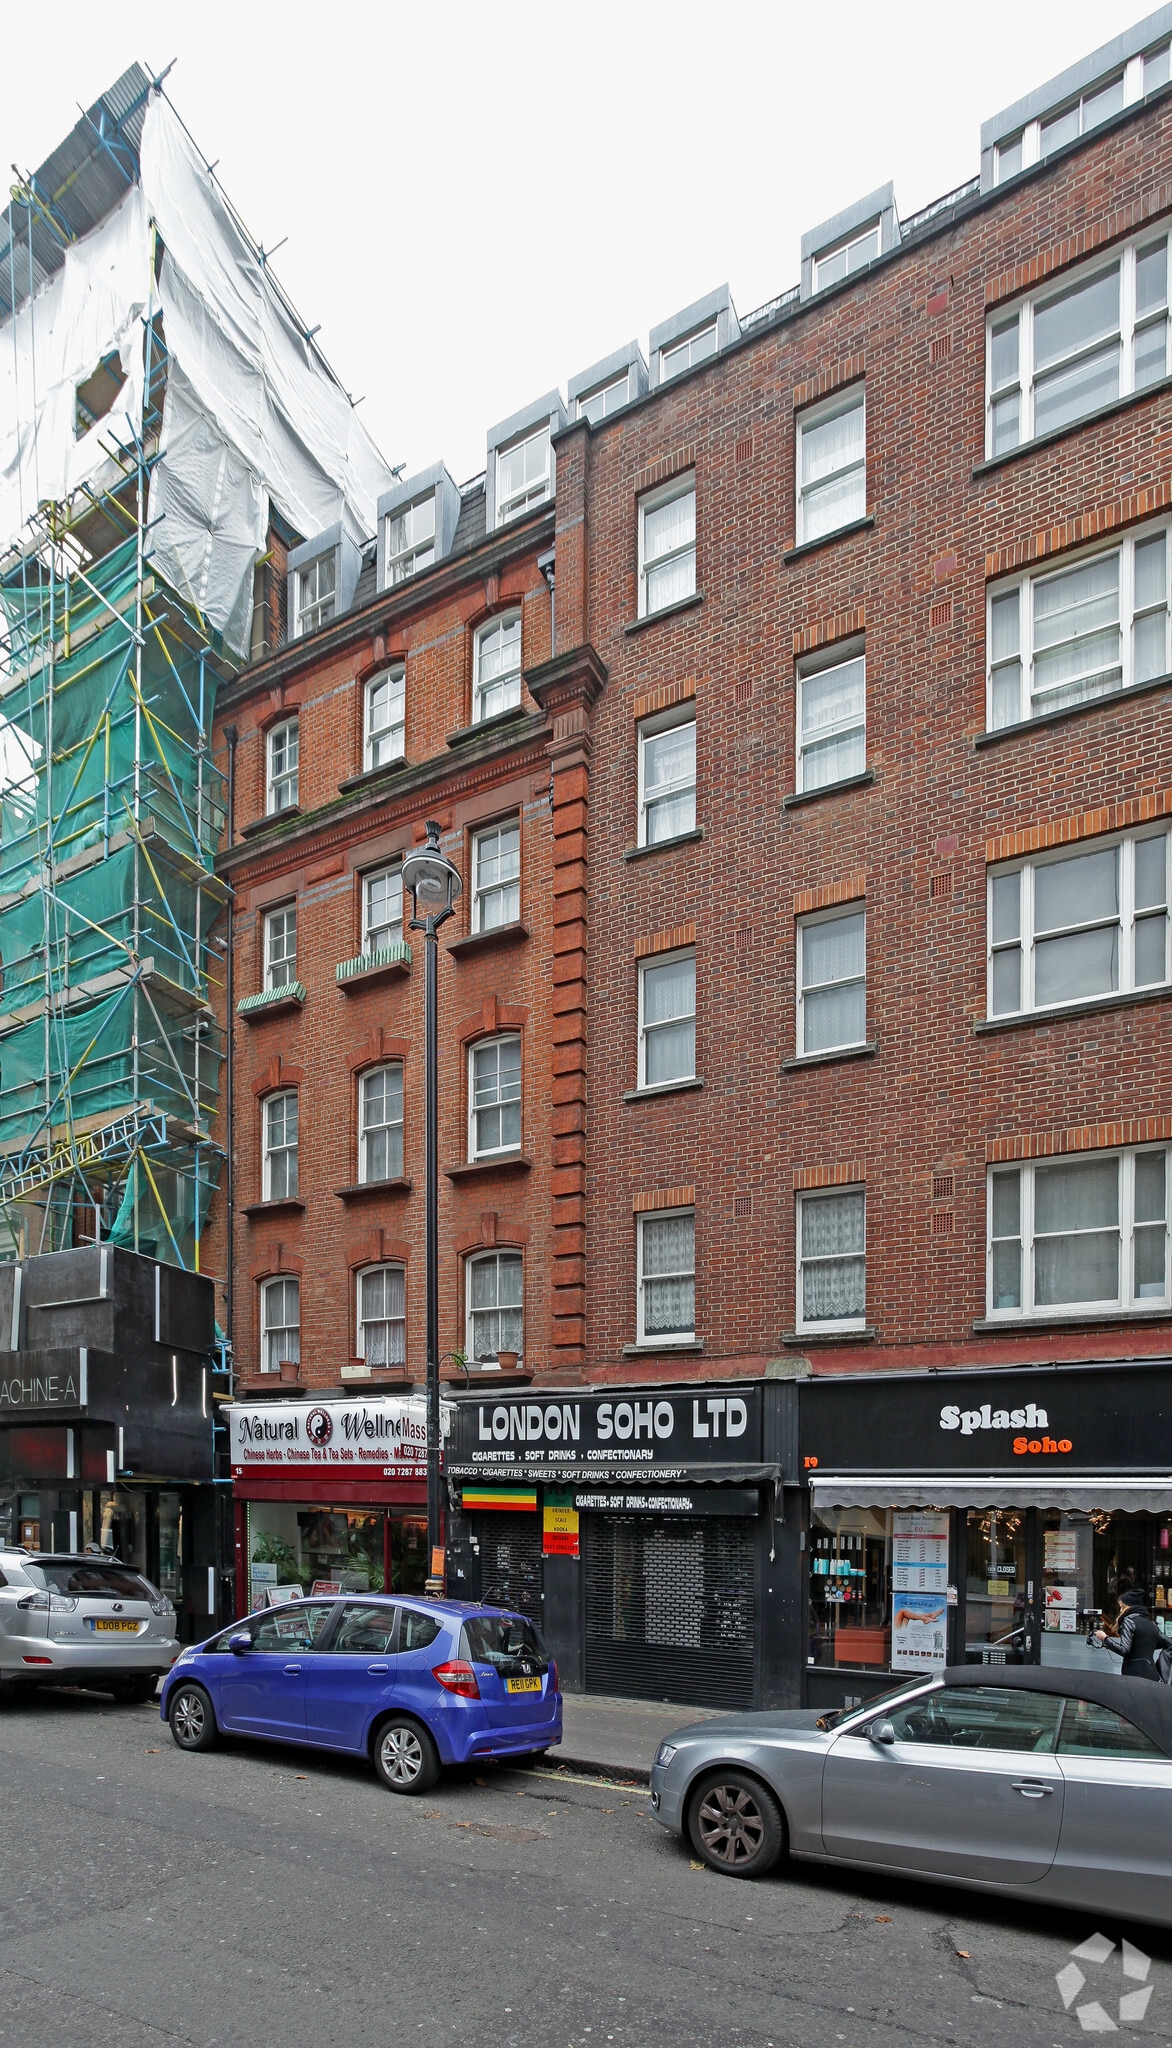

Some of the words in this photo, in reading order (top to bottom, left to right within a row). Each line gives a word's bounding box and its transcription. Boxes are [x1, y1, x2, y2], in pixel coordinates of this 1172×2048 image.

[478, 1404, 580, 1441] LONDON
[596, 1401, 674, 1440] SOHO
[693, 1398, 747, 1438] LTD
[939, 1403, 1049, 1435] Splash
[238, 1415, 299, 1444] Natural
[403, 1446, 414, 1457] 020
[1012, 1436, 1072, 1454] Soho
[243, 1448, 265, 1461] Chinese
[265, 1448, 283, 1461] Herbs
[286, 1447, 310, 1461] Chinese
[310, 1447, 321, 1460] Tea
[322, 1447, 327, 1460] &
[328, 1447, 339, 1460] Tea
[340, 1447, 353, 1460] Sets
[358, 1447, 389, 1460] Remedies
[472, 1450, 515, 1462] CIGARETTES
[525, 1450, 544, 1461] SOFT
[548, 1449, 576, 1461] DRINKS
[587, 1448, 653, 1461] CONFECTIONARY
[803, 1456, 818, 1468] 19
[235, 1467, 243, 1475] 15
[383, 1467, 396, 1476] 020
[396, 1467, 413, 1476] 7287
[447, 1466, 478, 1475] TOBACCO
[482, 1468, 523, 1477] CIGARETTES
[527, 1469, 557, 1478] SWEETS
[561, 1470, 581, 1479] SOFT
[581, 1470, 610, 1479] DRINKS
[615, 1469, 683, 1479] CONFECTIONERY
[575, 1494, 607, 1508] CIGARETTES
[609, 1495, 624, 1509] SOFT
[626, 1495, 645, 1509] DRINKS
[996, 1565, 1016, 1574] CLOSED
[96, 1620, 120, 1630] LD08
[121, 1621, 138, 1631] PGZ
[525, 1678, 538, 1689] GPK
